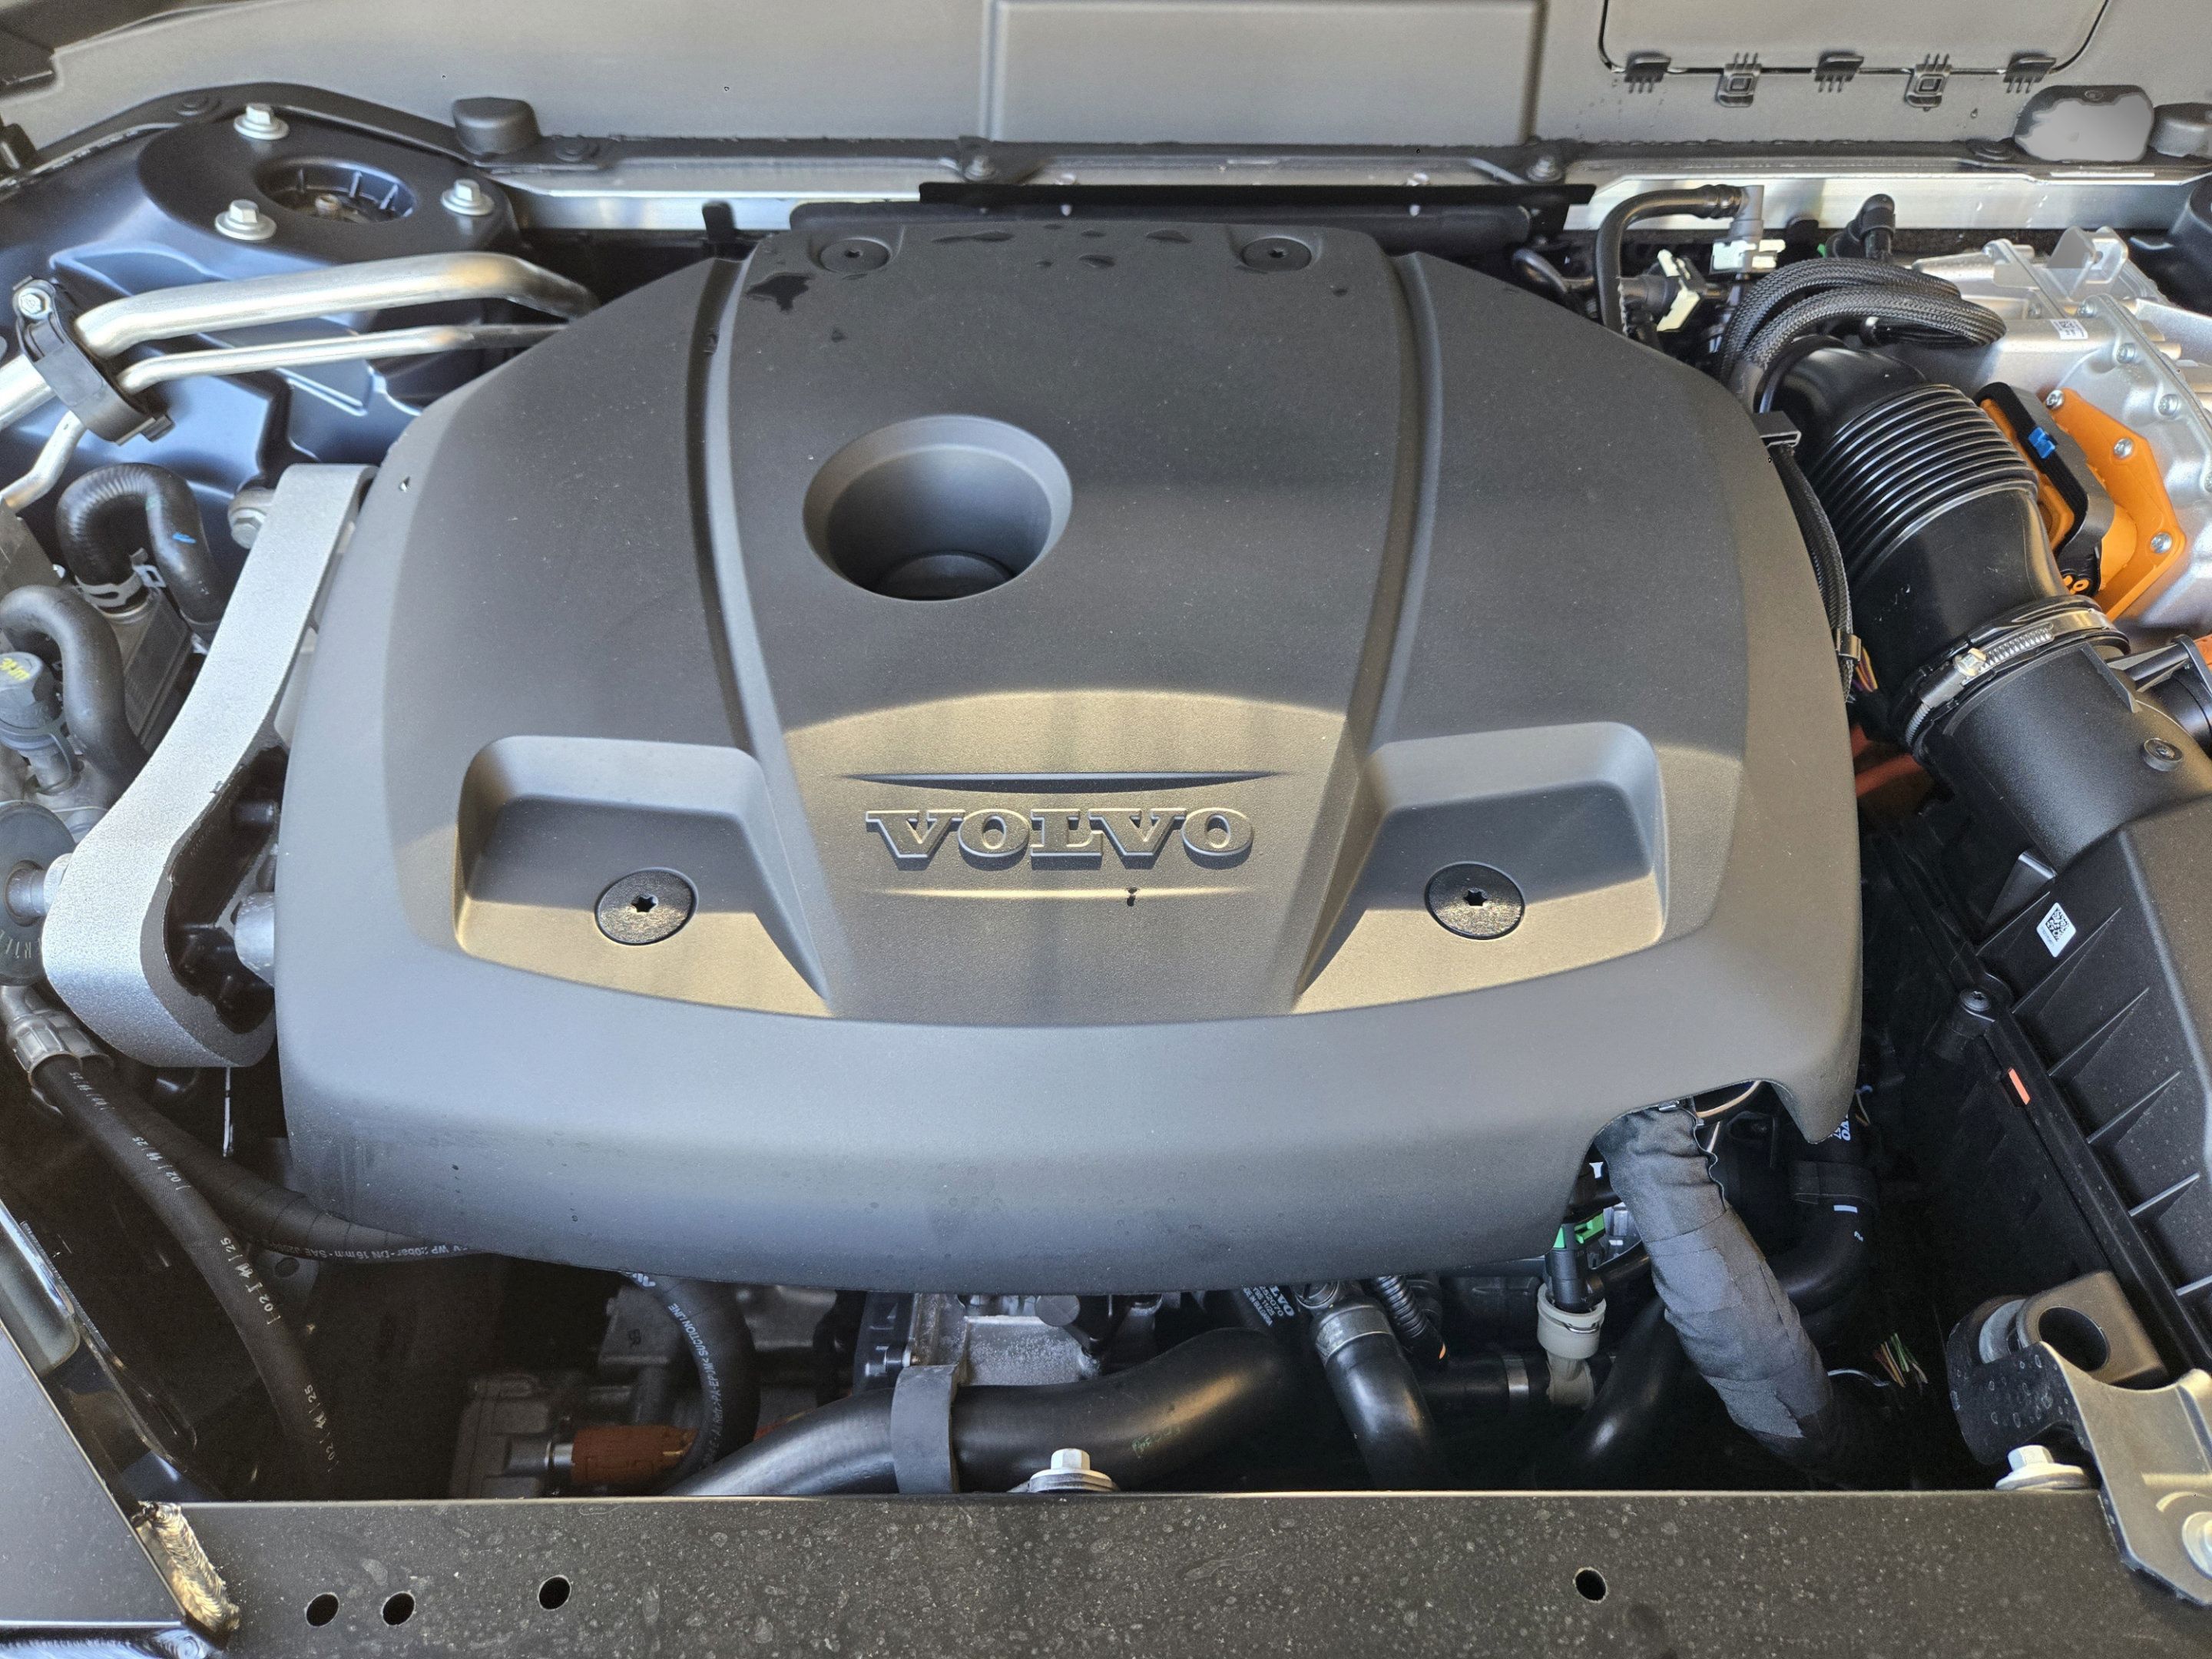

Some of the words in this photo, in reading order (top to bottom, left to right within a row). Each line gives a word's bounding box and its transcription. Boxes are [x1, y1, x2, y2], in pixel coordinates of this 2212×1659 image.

[866, 807, 1254, 864] VOLVO
[132, 1136, 149, 1147] 25
[165, 1171, 182, 1184] 02
[220, 1237, 236, 1253] 25
[258, 1294, 274, 1313] 02
[1270, 1286, 1295, 1316] LVO
[682, 1320, 709, 1358] SUCTION
[304, 1385, 318, 1403] 25
